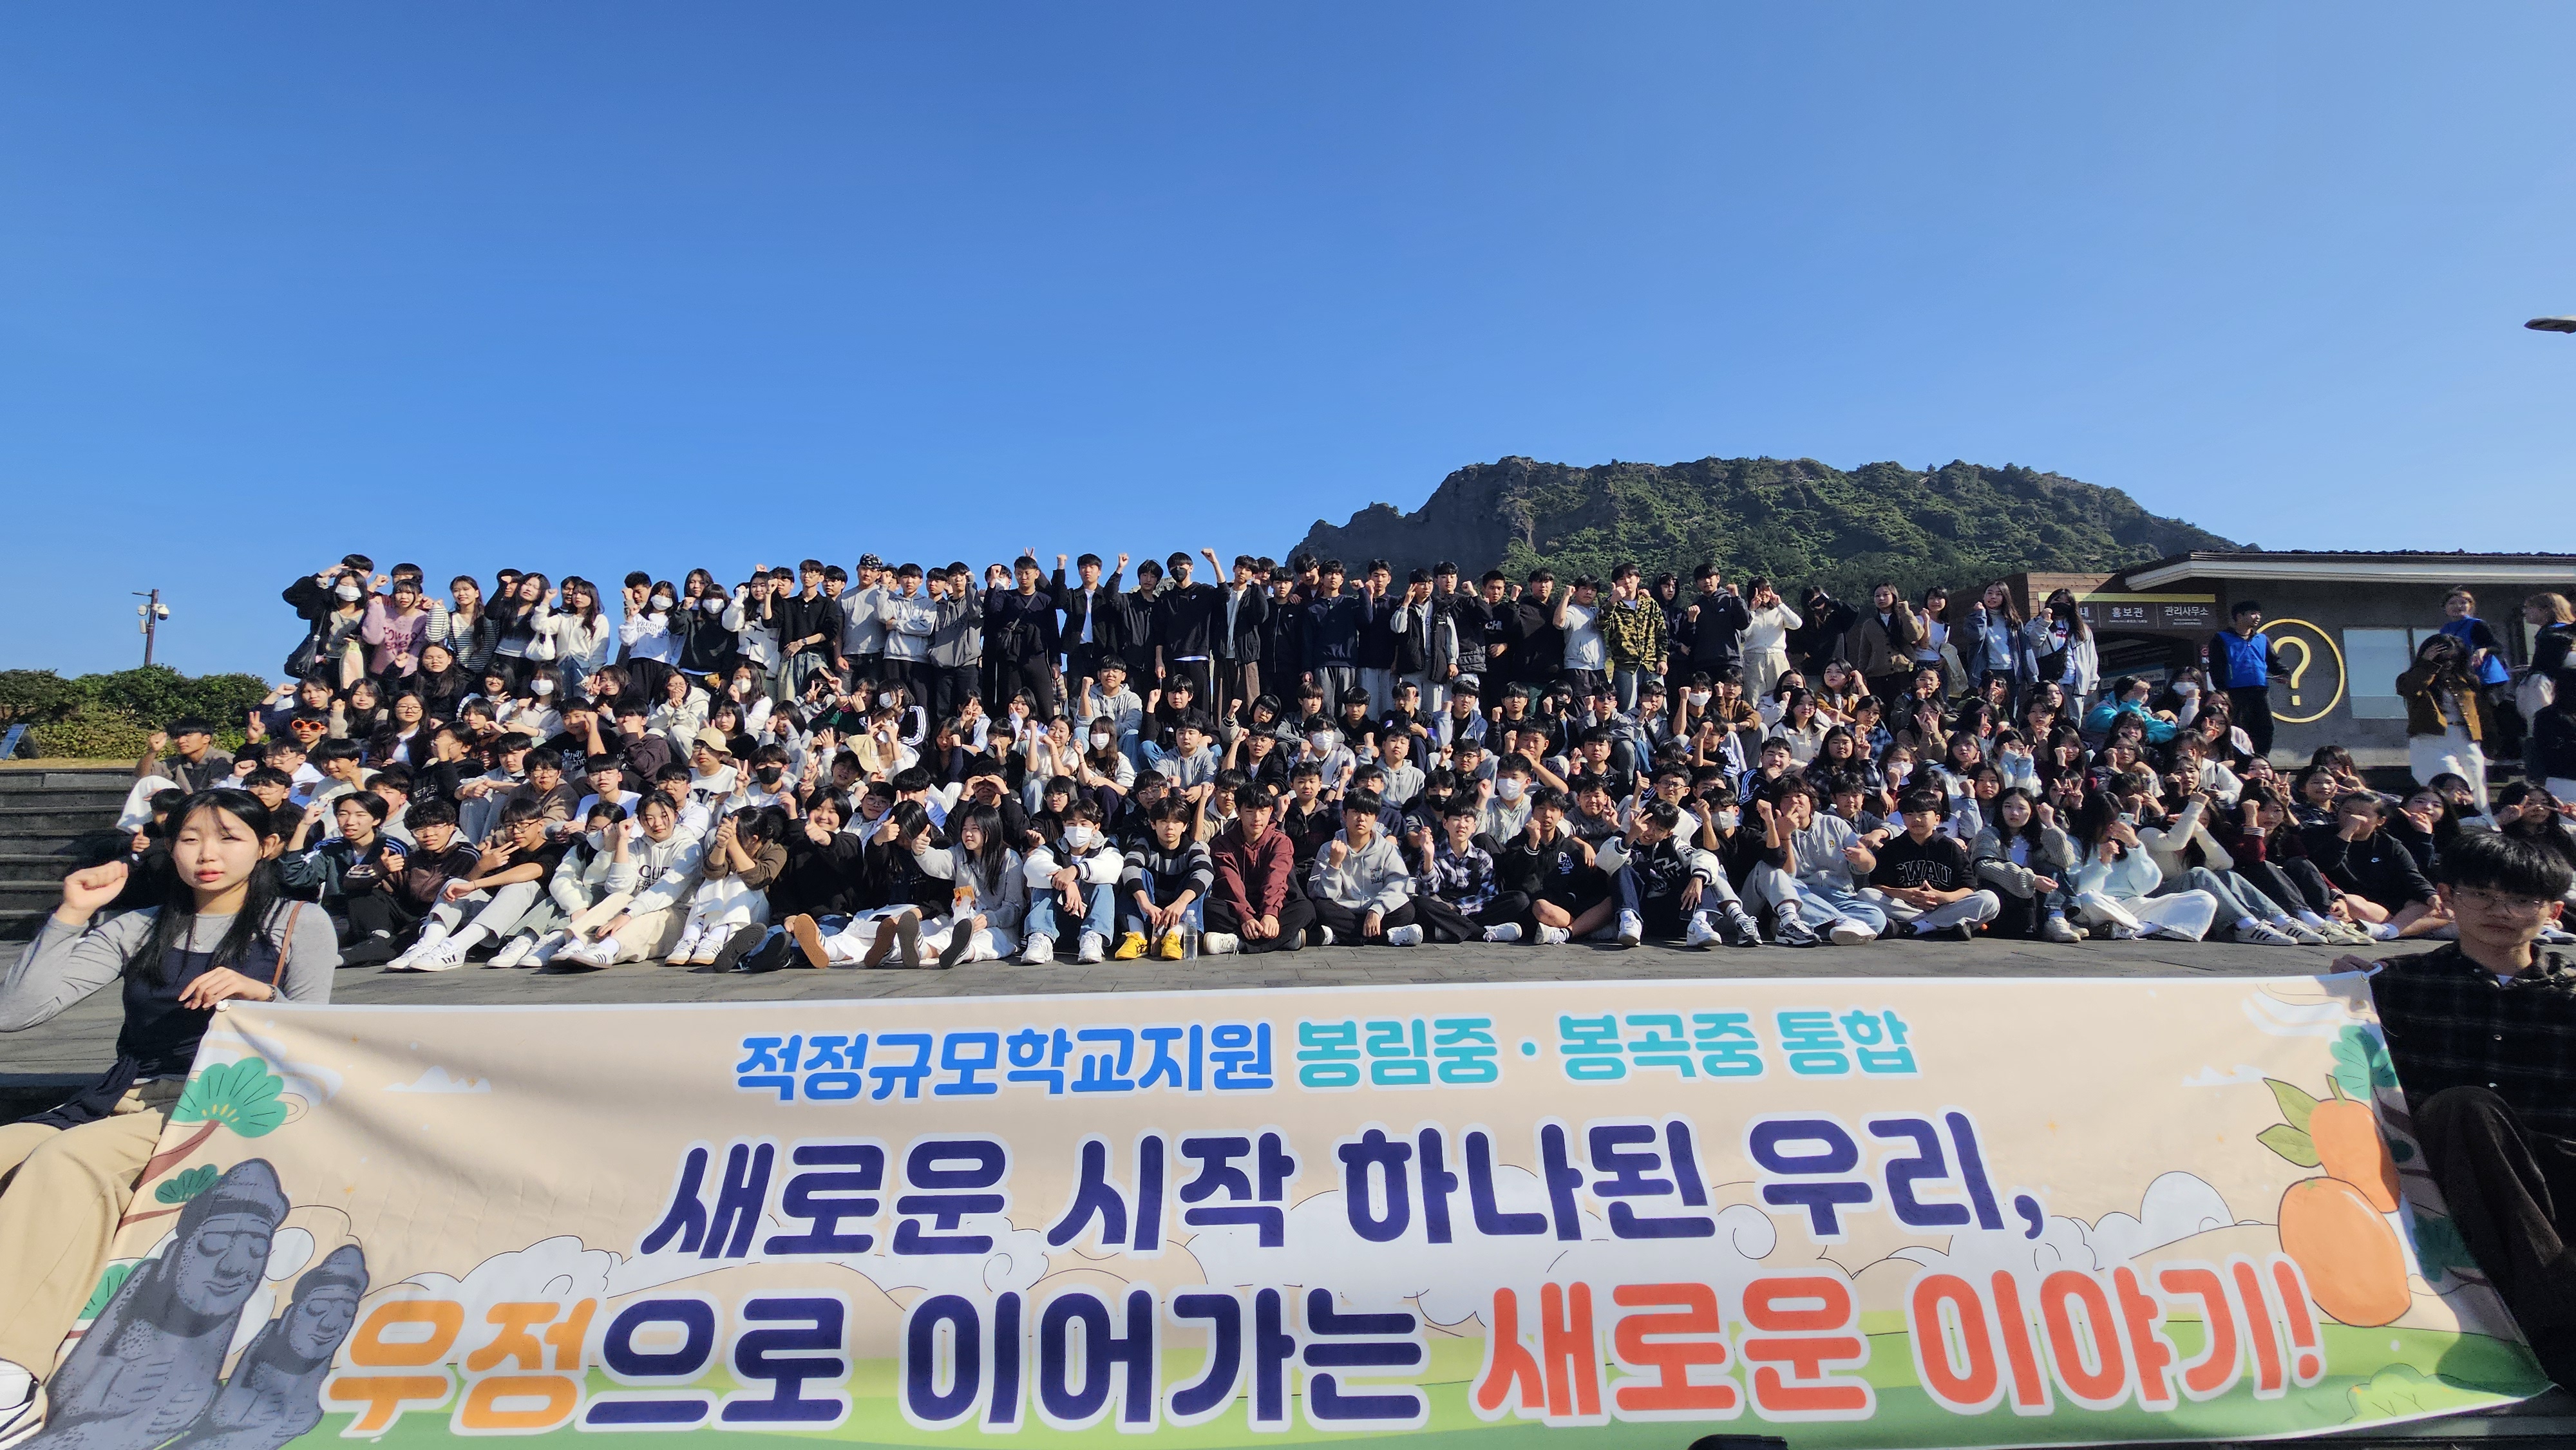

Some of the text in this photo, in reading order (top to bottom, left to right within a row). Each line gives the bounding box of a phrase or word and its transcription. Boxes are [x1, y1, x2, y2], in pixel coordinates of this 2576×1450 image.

[2079, 607, 2089, 617] 내
[2112, 607, 2145, 617] 홍보관
[2164, 606, 2209, 616] 관리사무소
[736, 1022, 1274, 1100] 적정규모학교지원
[1296, 1018, 1498, 1088] 봉림중
[1559, 1013, 1763, 1080] 봉곡중
[1777, 1009, 1918, 1075] 통합
[640, 1112, 2043, 1259] 새로운 시작 하나된 우리,
[329, 1261, 2320, 1429] 우정으로 이어가는 새로운 이야기!
